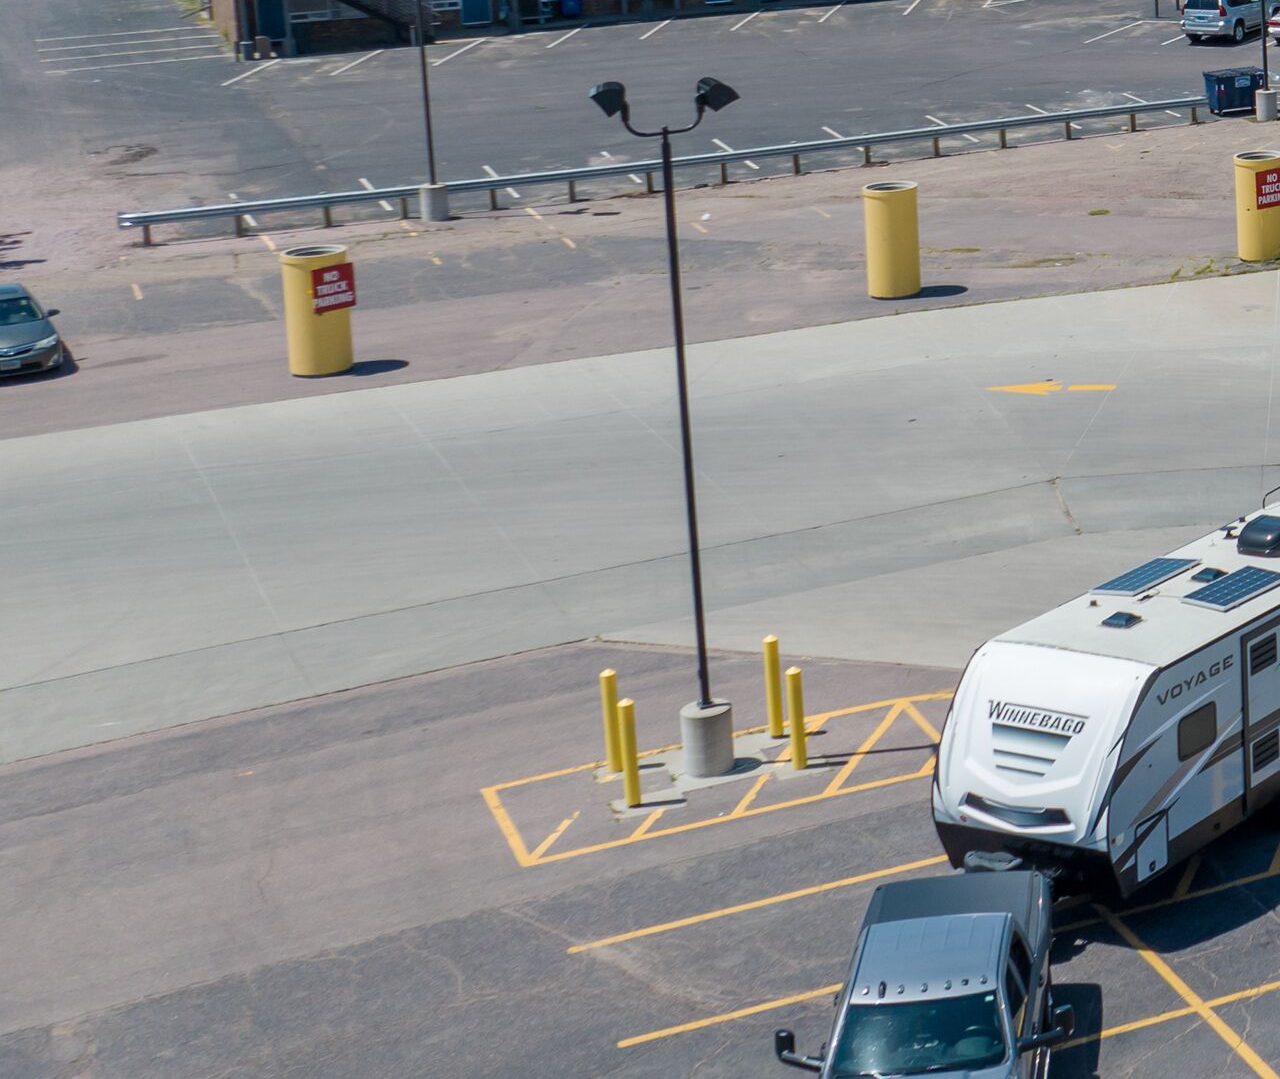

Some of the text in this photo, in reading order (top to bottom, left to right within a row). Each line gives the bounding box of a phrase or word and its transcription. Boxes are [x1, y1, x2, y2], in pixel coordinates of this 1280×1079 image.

[1266, 173, 1277, 183] NO
[323, 271, 339, 282] NO
[316, 281, 348, 296] TRUCK
[313, 292, 354, 308] PARKING
[1156, 653, 1234, 706] VOYAGE
